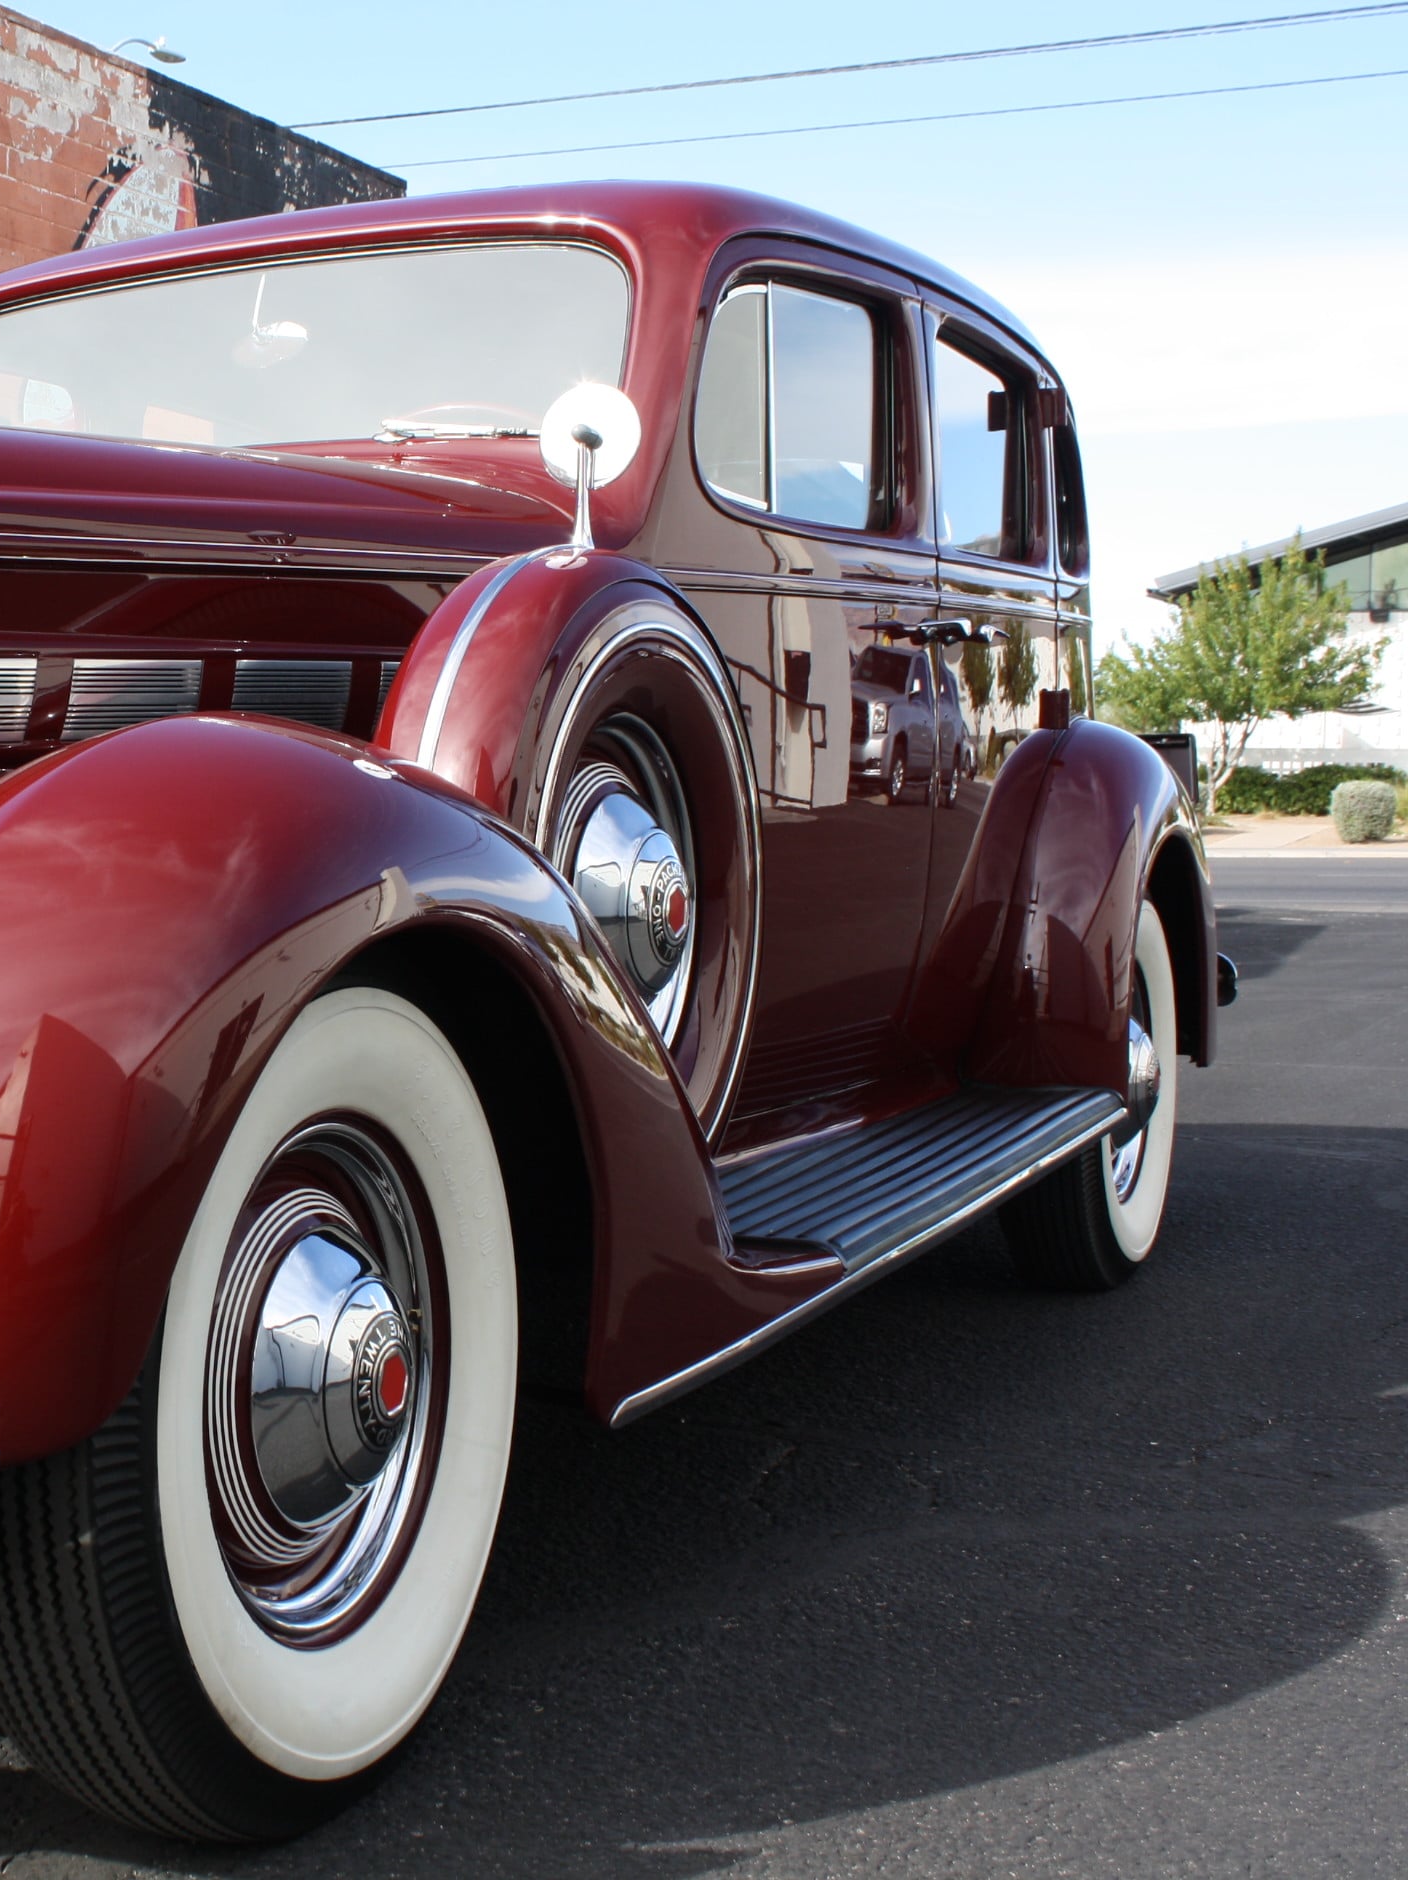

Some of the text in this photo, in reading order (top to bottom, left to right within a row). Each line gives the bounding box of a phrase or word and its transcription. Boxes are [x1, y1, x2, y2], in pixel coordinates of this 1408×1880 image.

[656, 862, 687, 893] PACK
[652, 904, 665, 946] ONE
[358, 1327, 387, 1428] TWENTY
